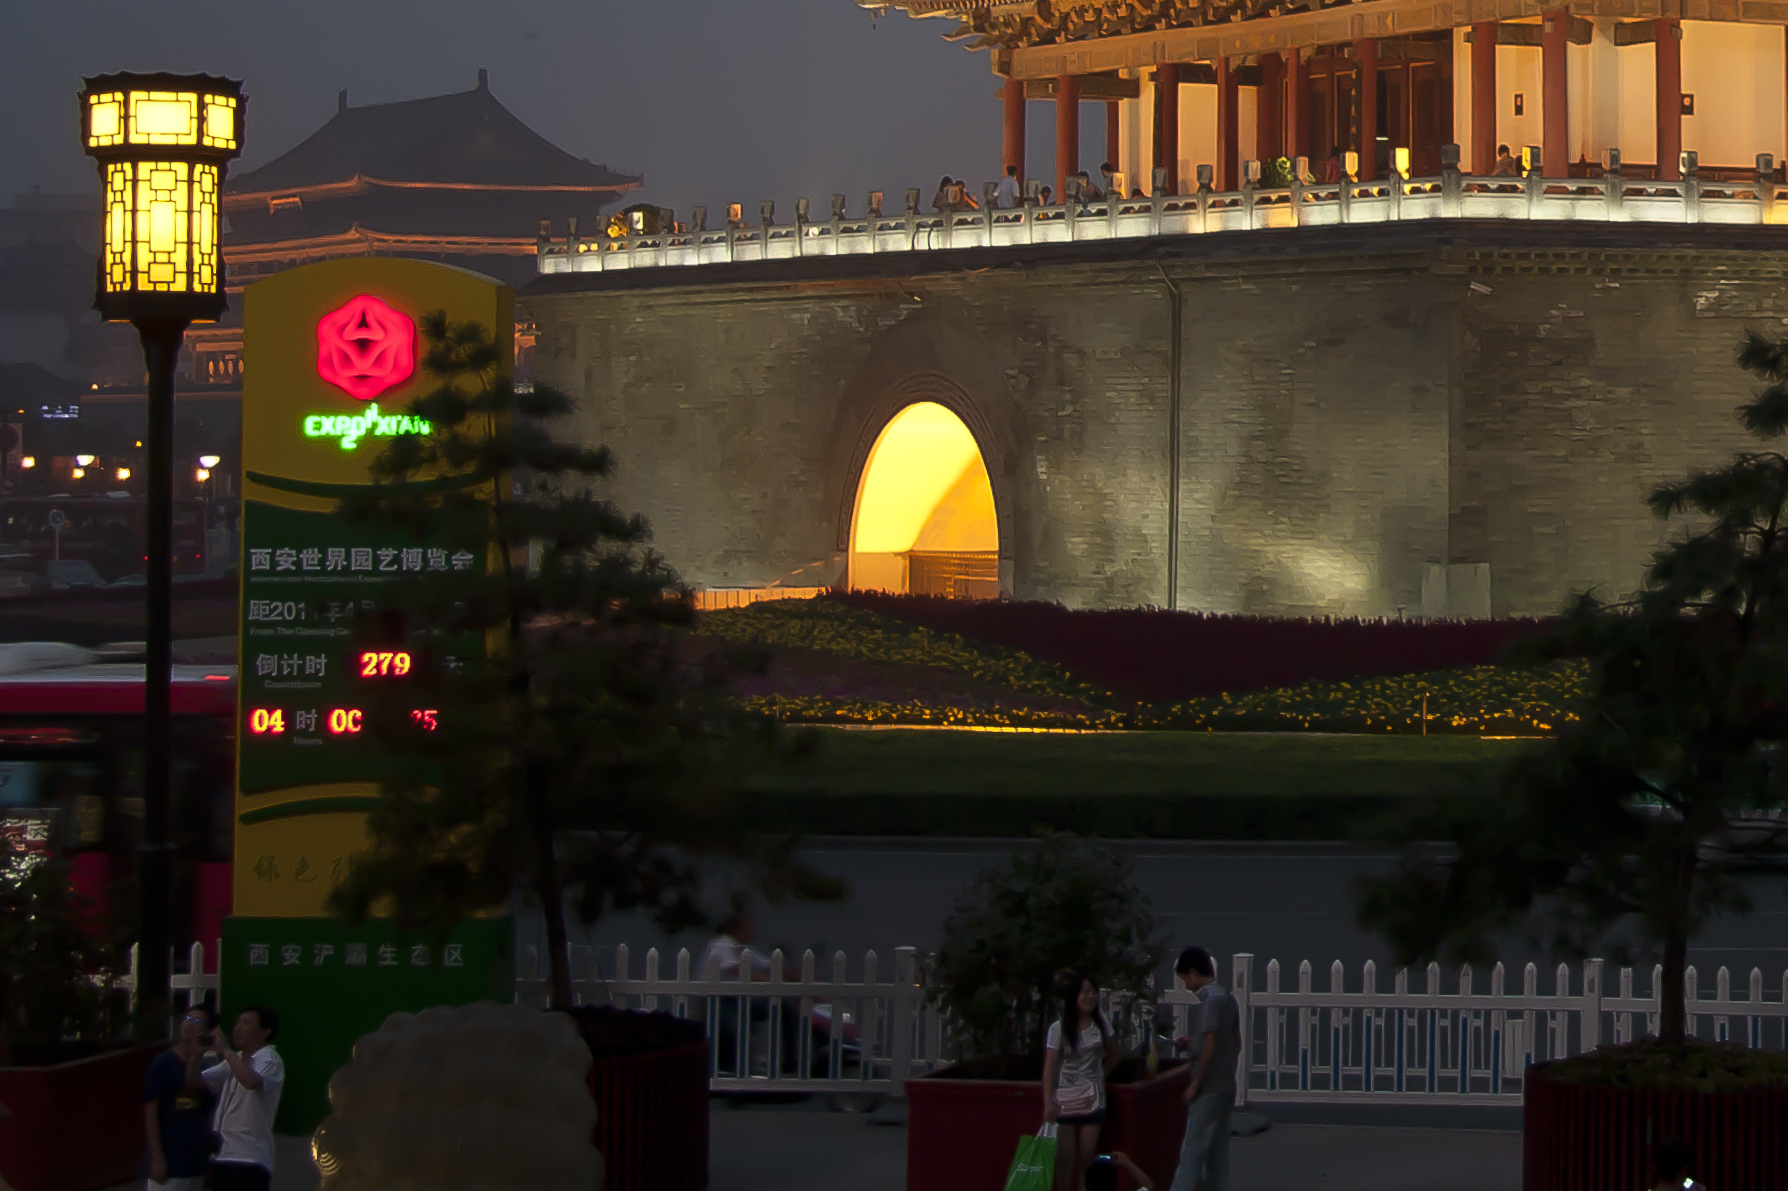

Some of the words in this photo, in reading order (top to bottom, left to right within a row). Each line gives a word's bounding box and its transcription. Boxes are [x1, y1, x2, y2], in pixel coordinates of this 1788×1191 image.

[249, 547, 474, 572] 西安世界园艺博览会
[256, 652, 328, 677] 倒计时
[361, 652, 411, 677] 279
[251, 709, 285, 733] 04
[295, 710, 317, 732] 时
